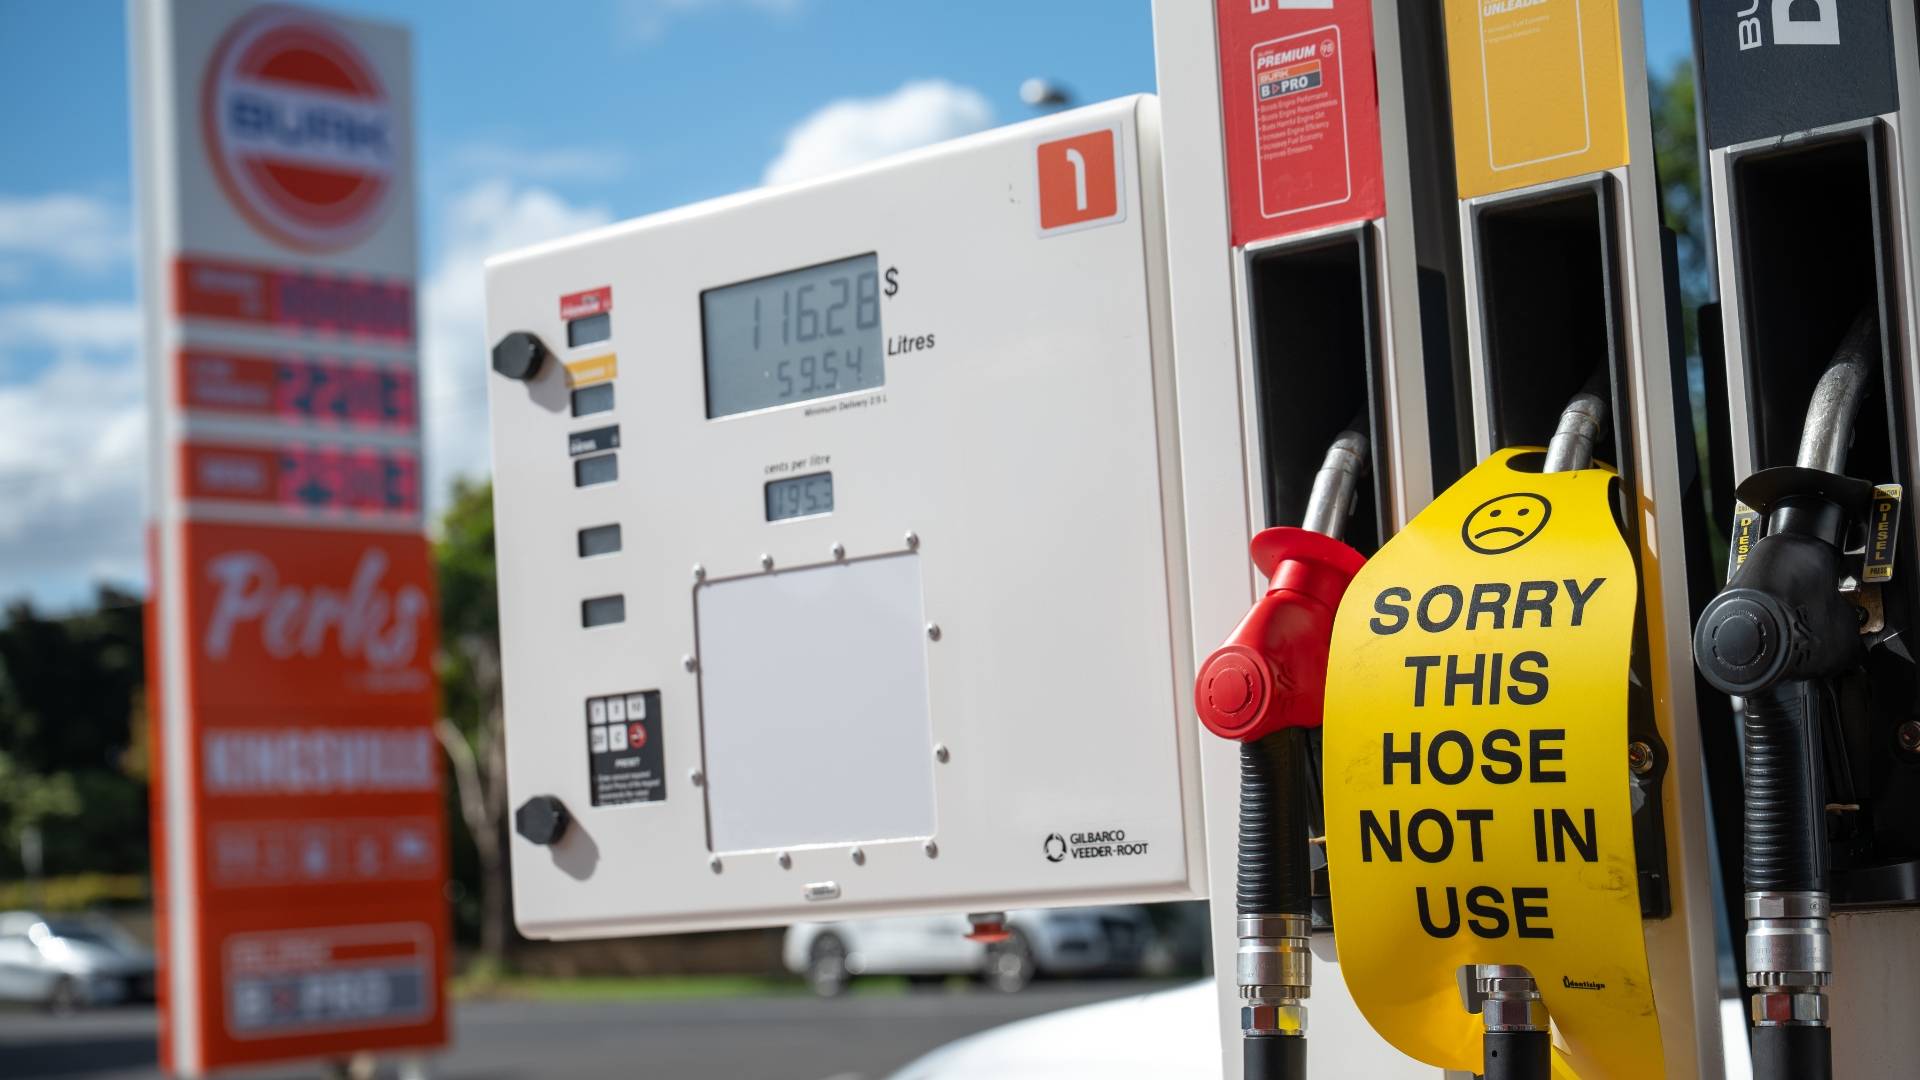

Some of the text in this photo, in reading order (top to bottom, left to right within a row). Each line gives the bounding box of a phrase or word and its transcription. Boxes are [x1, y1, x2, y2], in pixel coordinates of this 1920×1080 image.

[1257, 44, 1316, 69] PREMIUM
[1261, 76, 1308, 98] B PRO
[1066, 148, 1088, 211] 1
[884, 266, 899, 298] $
[753, 270, 879, 351] 116.28
[888, 333, 935, 356] Litres
[777, 346, 863, 398] 59.54
[764, 454, 830, 474] cents per litre
[1876, 503, 1891, 560] DIESEL
[203, 547, 427, 668] Perks
[1369, 577, 1606, 636] SORRY
[1404, 651, 1549, 707] THIS
[204, 729, 435, 793] KINGSVILLE
[1382, 728, 1567, 785] HOSE
[1070, 830, 1125, 845] GILBARCO
[1071, 843, 1149, 859] VEEDER-ROOT
[1359, 808, 1598, 863] NOT IN
[1416, 886, 1554, 939] USE
